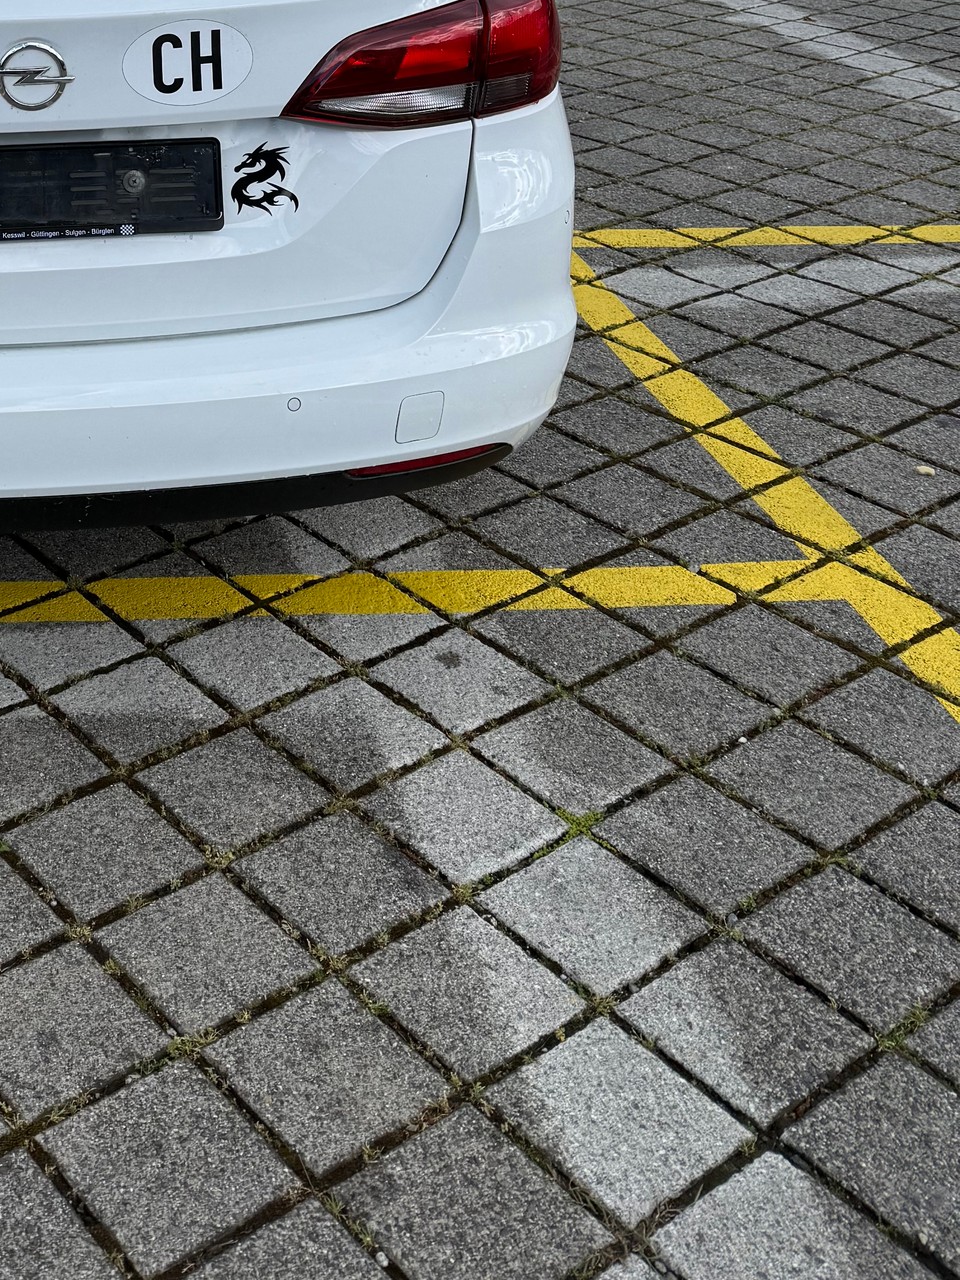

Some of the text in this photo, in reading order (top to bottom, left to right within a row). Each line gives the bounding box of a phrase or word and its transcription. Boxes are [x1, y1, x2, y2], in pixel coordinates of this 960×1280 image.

[152, 29, 223, 94] CH
[2, 231, 26, 239] Kesswil
[31, 230, 59, 239] Güttingen
[65, 229, 86, 237] Sulgen
[91, 228, 114, 236] Bürglen
